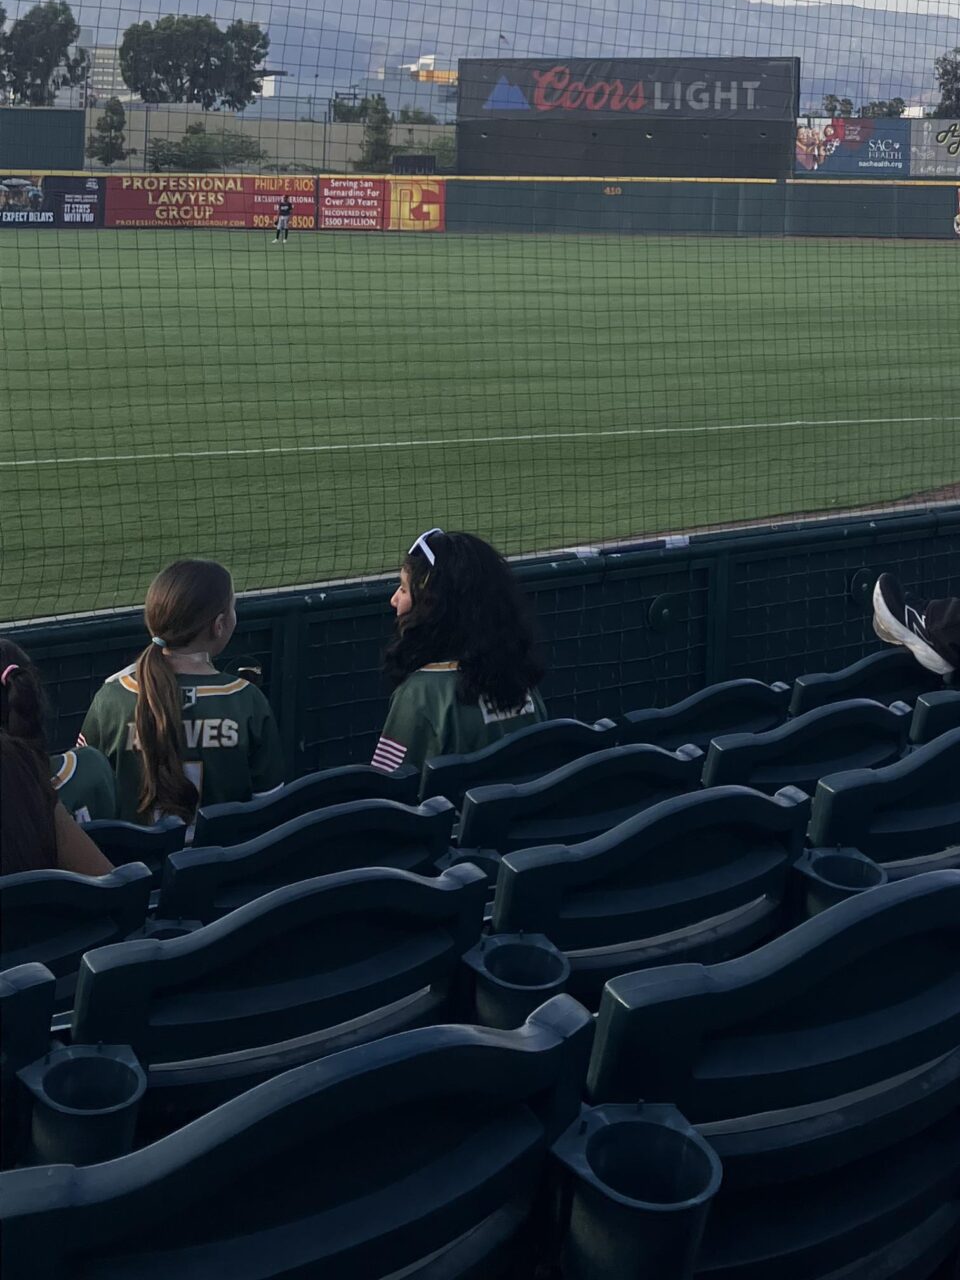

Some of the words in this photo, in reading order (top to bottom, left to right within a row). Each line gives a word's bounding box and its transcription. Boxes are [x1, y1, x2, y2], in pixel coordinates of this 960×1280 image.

[532, 66, 647, 111] Coors
[654, 80, 761, 111] LIGHT
[868, 139, 892, 152] SAC
[868, 151, 902, 160] HEALTH
[858, 160, 903, 169] sachealth.org
[122, 177, 244, 191] PROFESSIONAL
[255, 179, 284, 191] PHILIP
[294, 179, 314, 192] RIOS
[331, 179, 359, 189] Serving
[324, 188, 366, 197] Bernardino
[367, 189, 380, 197] For
[148, 191, 225, 205] LAWYERS
[325, 197, 344, 206] Over
[64, 204, 71, 213] IT
[72, 204, 91, 213] STAYS
[155, 206, 214, 219] GROUP
[3, 212, 28, 222] EXPECT
[28, 212, 54, 222] DELAYS
[64, 213, 80, 222] WITH
[81, 213, 94, 223] YOU
[253, 215, 315, 228] 909--8500
[344, 218, 376, 226] MILLION
